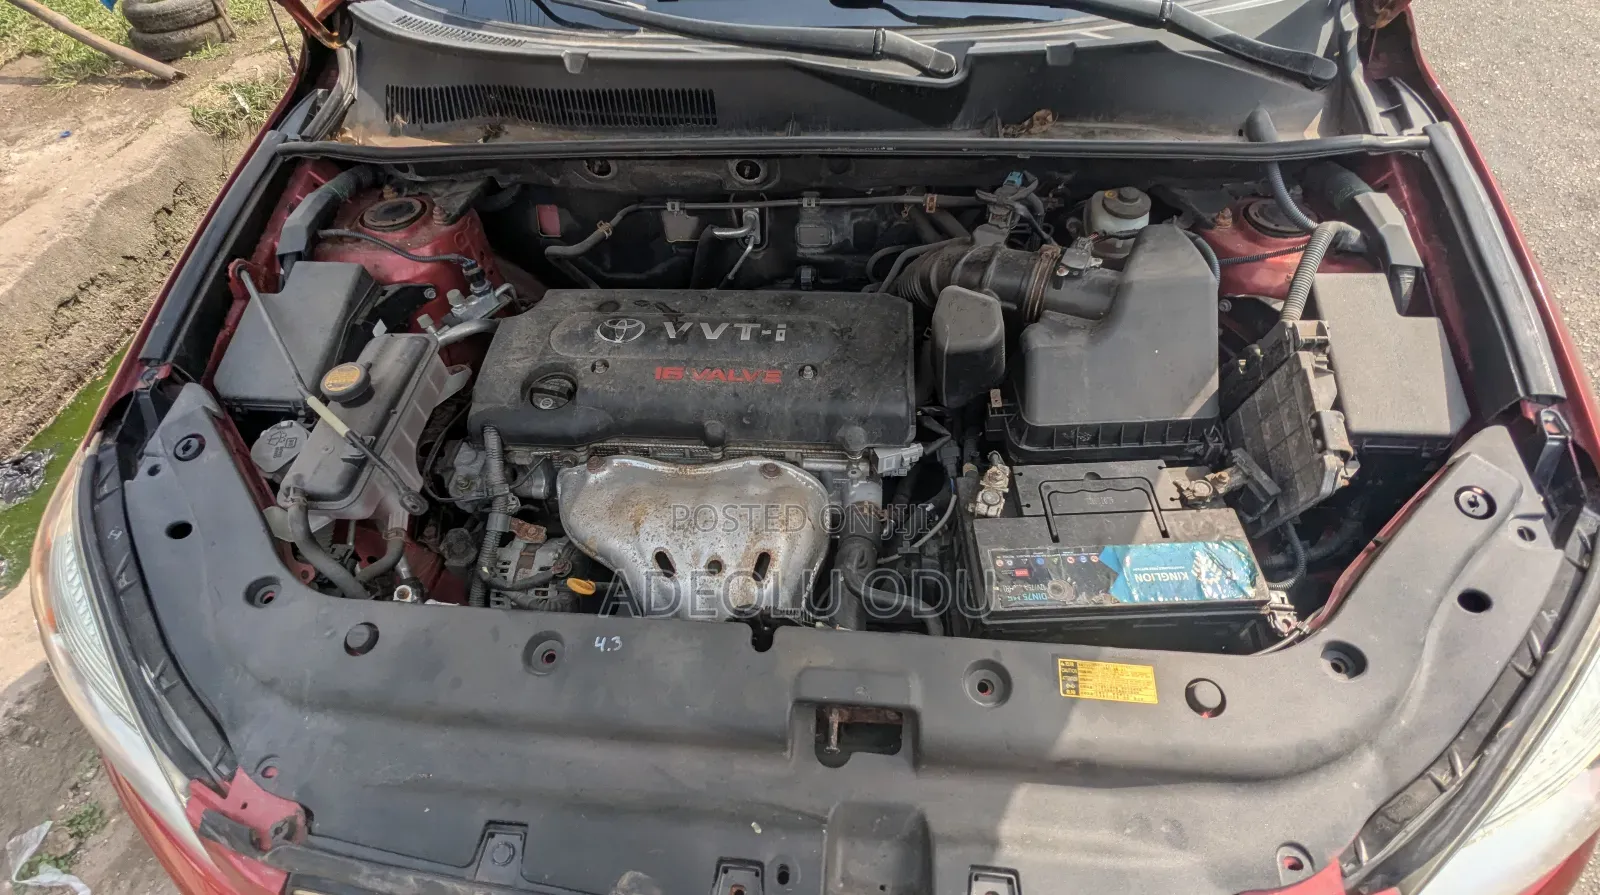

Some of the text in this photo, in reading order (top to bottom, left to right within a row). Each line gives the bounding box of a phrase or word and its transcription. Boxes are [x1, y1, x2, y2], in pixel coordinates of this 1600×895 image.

[663, 321, 787, 342] VVT-i
[655, 366, 782, 384] 16 VALVE
[1133, 571, 1190, 583] KINGLION
[1022, 592, 1048, 601] DIN75
[593, 636, 623, 652] 4.3
